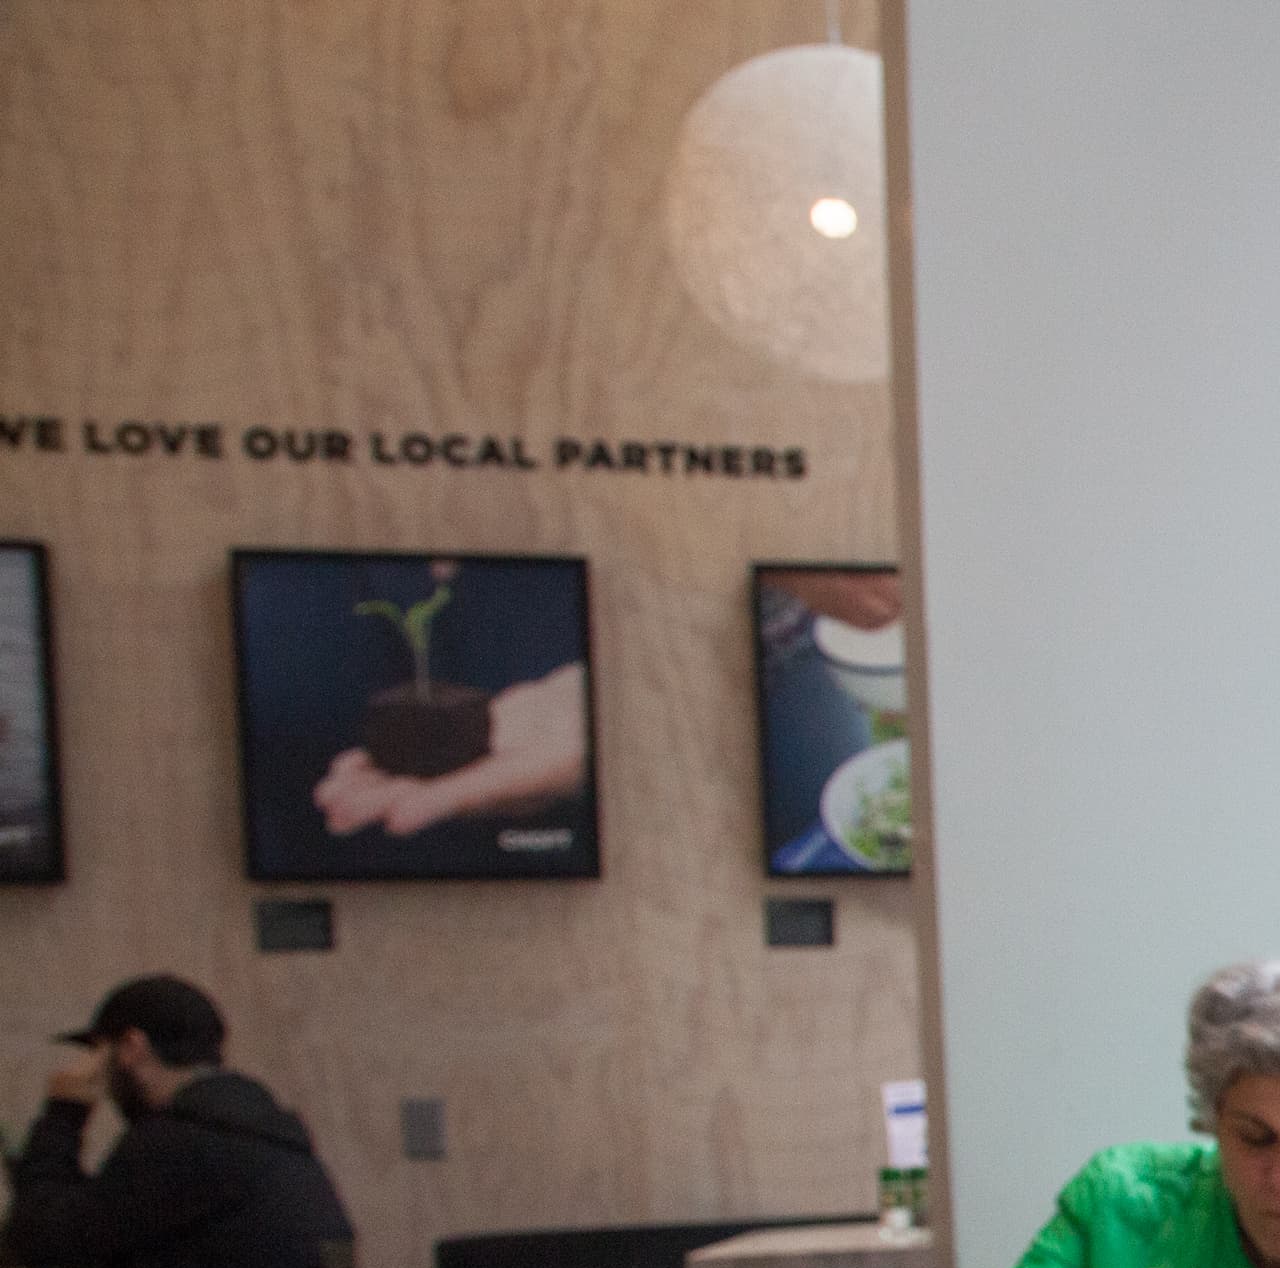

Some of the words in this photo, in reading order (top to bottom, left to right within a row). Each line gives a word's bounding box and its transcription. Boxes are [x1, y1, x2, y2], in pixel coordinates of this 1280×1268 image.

[82, 421, 223, 460] LOVE
[242, 425, 354, 464] OUR
[370, 431, 537, 472] LOCAL
[553, 437, 808, 481] PARTNERS
